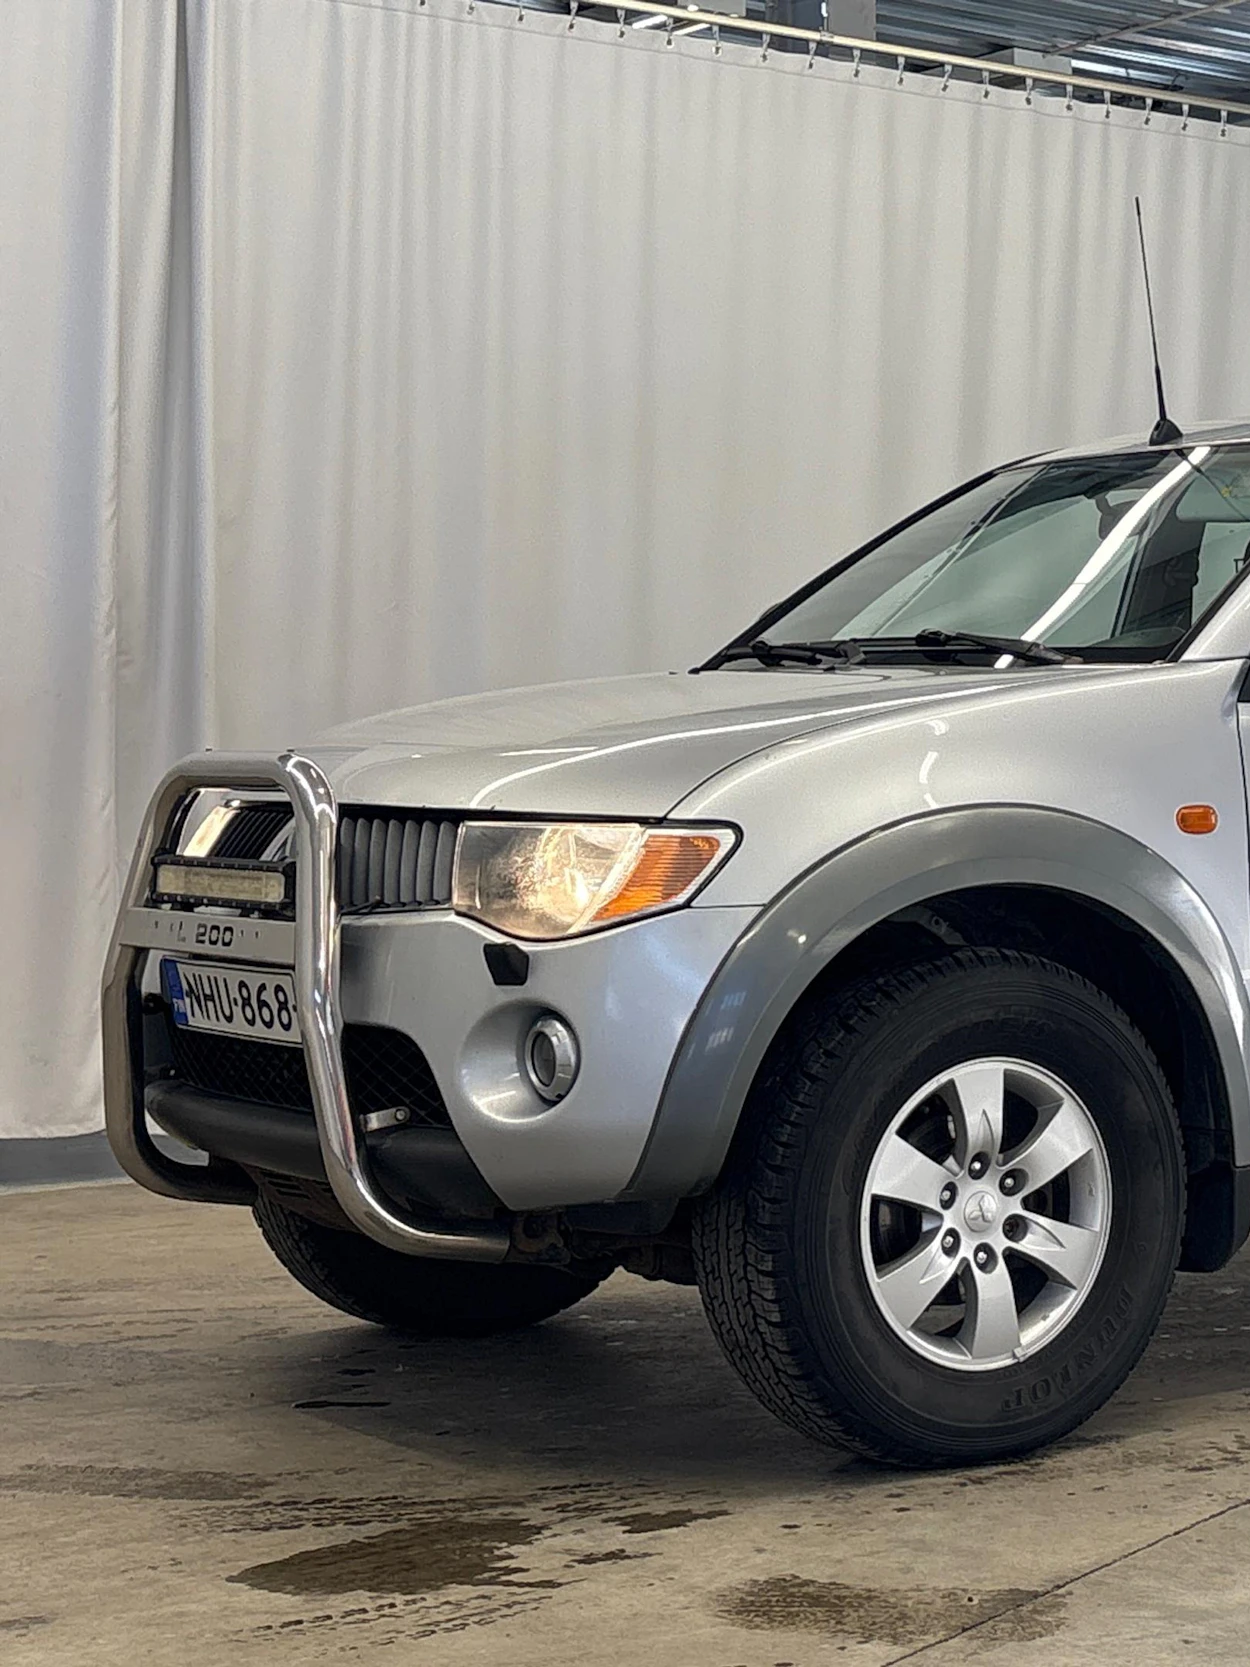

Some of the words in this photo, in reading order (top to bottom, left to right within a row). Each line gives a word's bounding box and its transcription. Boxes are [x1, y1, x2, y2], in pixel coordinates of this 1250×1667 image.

[194, 922, 235, 947] 200
[182, 971, 293, 1032] NHU-868
[1000, 1280, 1134, 1413] DUNLOP
